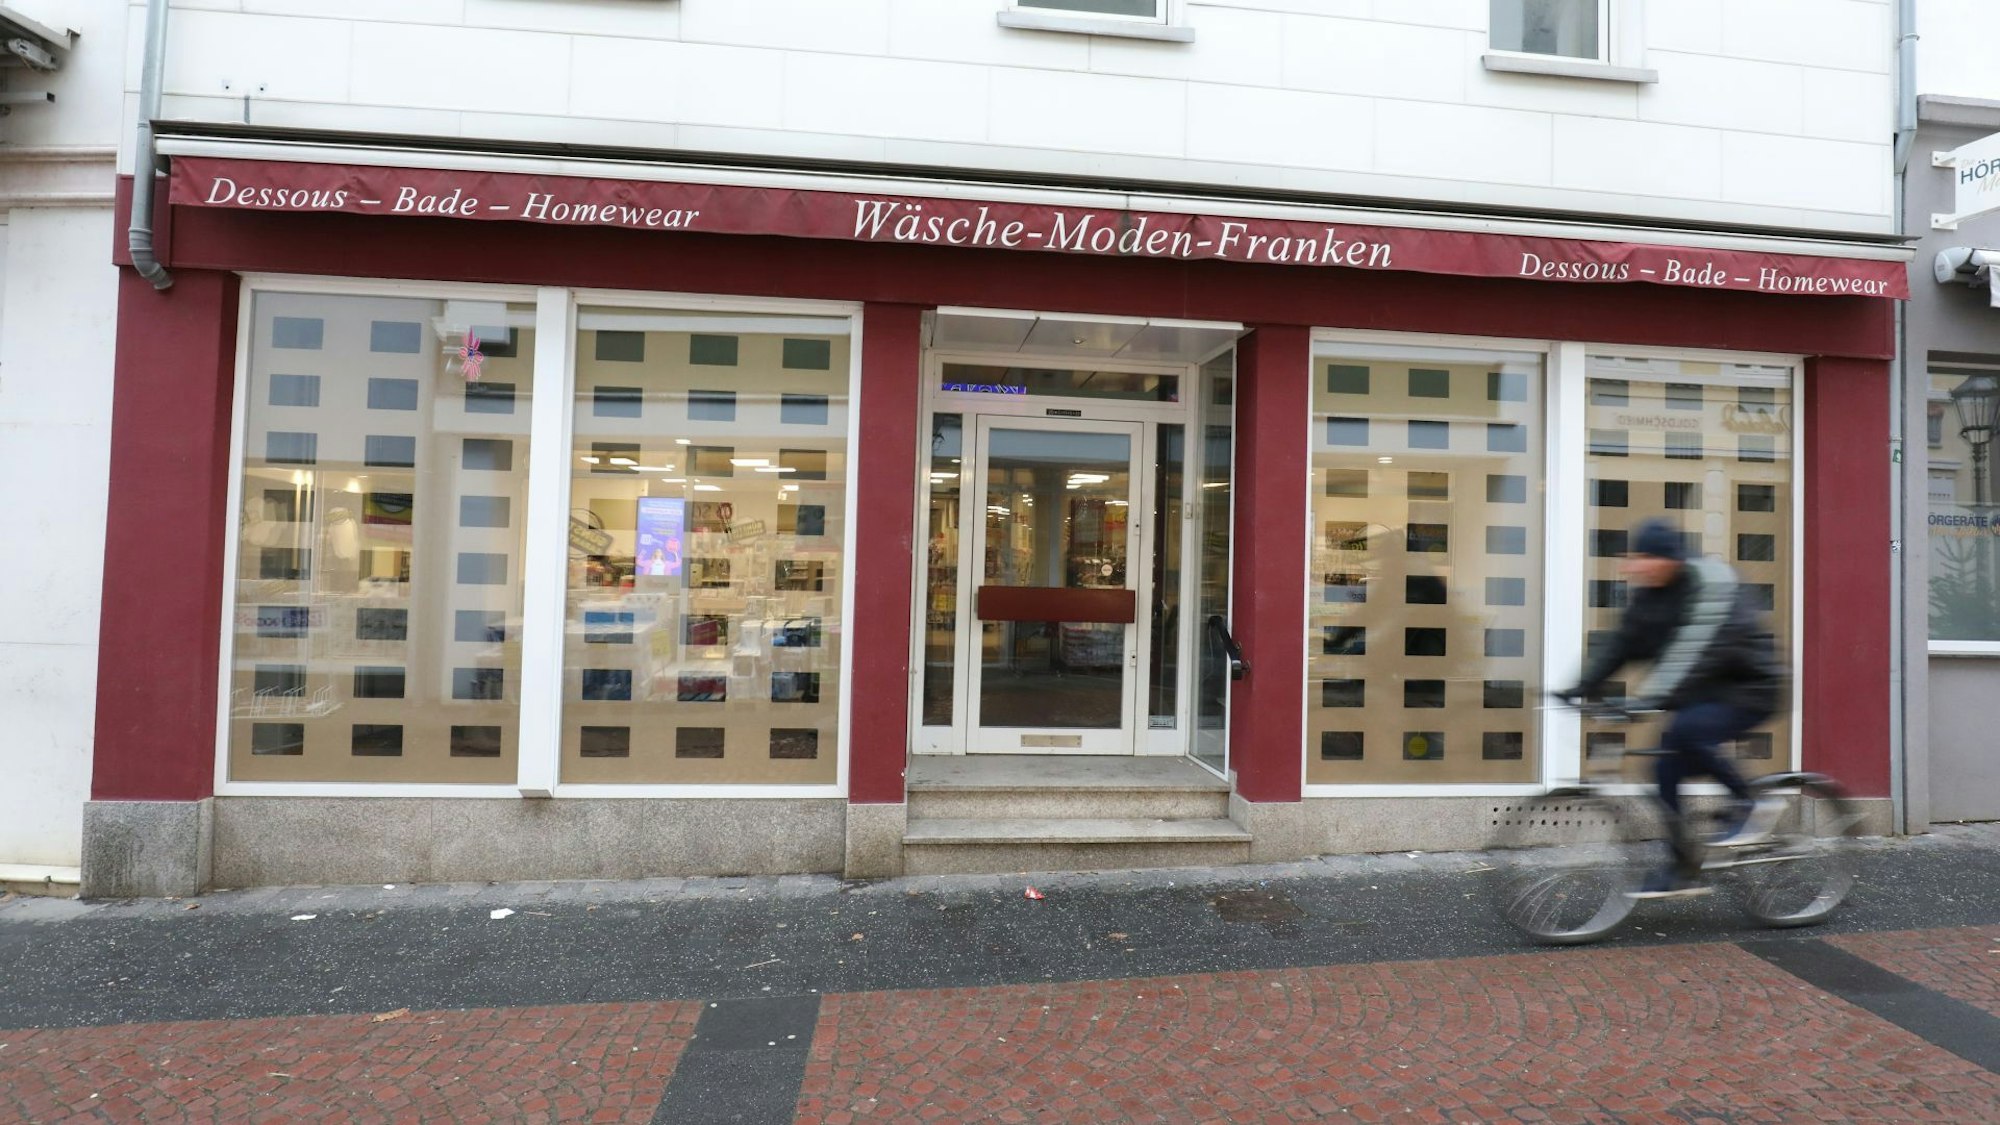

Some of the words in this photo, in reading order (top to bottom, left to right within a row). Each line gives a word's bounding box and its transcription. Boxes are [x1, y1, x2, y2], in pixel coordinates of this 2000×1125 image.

[205, 178, 347, 207] Dessous
[392, 187, 477, 215] Bade
[521, 193, 699, 227] Homewear
[853, 199, 1392, 268] Wäsche-Moden-Franken
[1520, 253, 1628, 279] Dessous
[1664, 259, 1725, 285] Bade
[1759, 268, 1887, 294] Homewear
